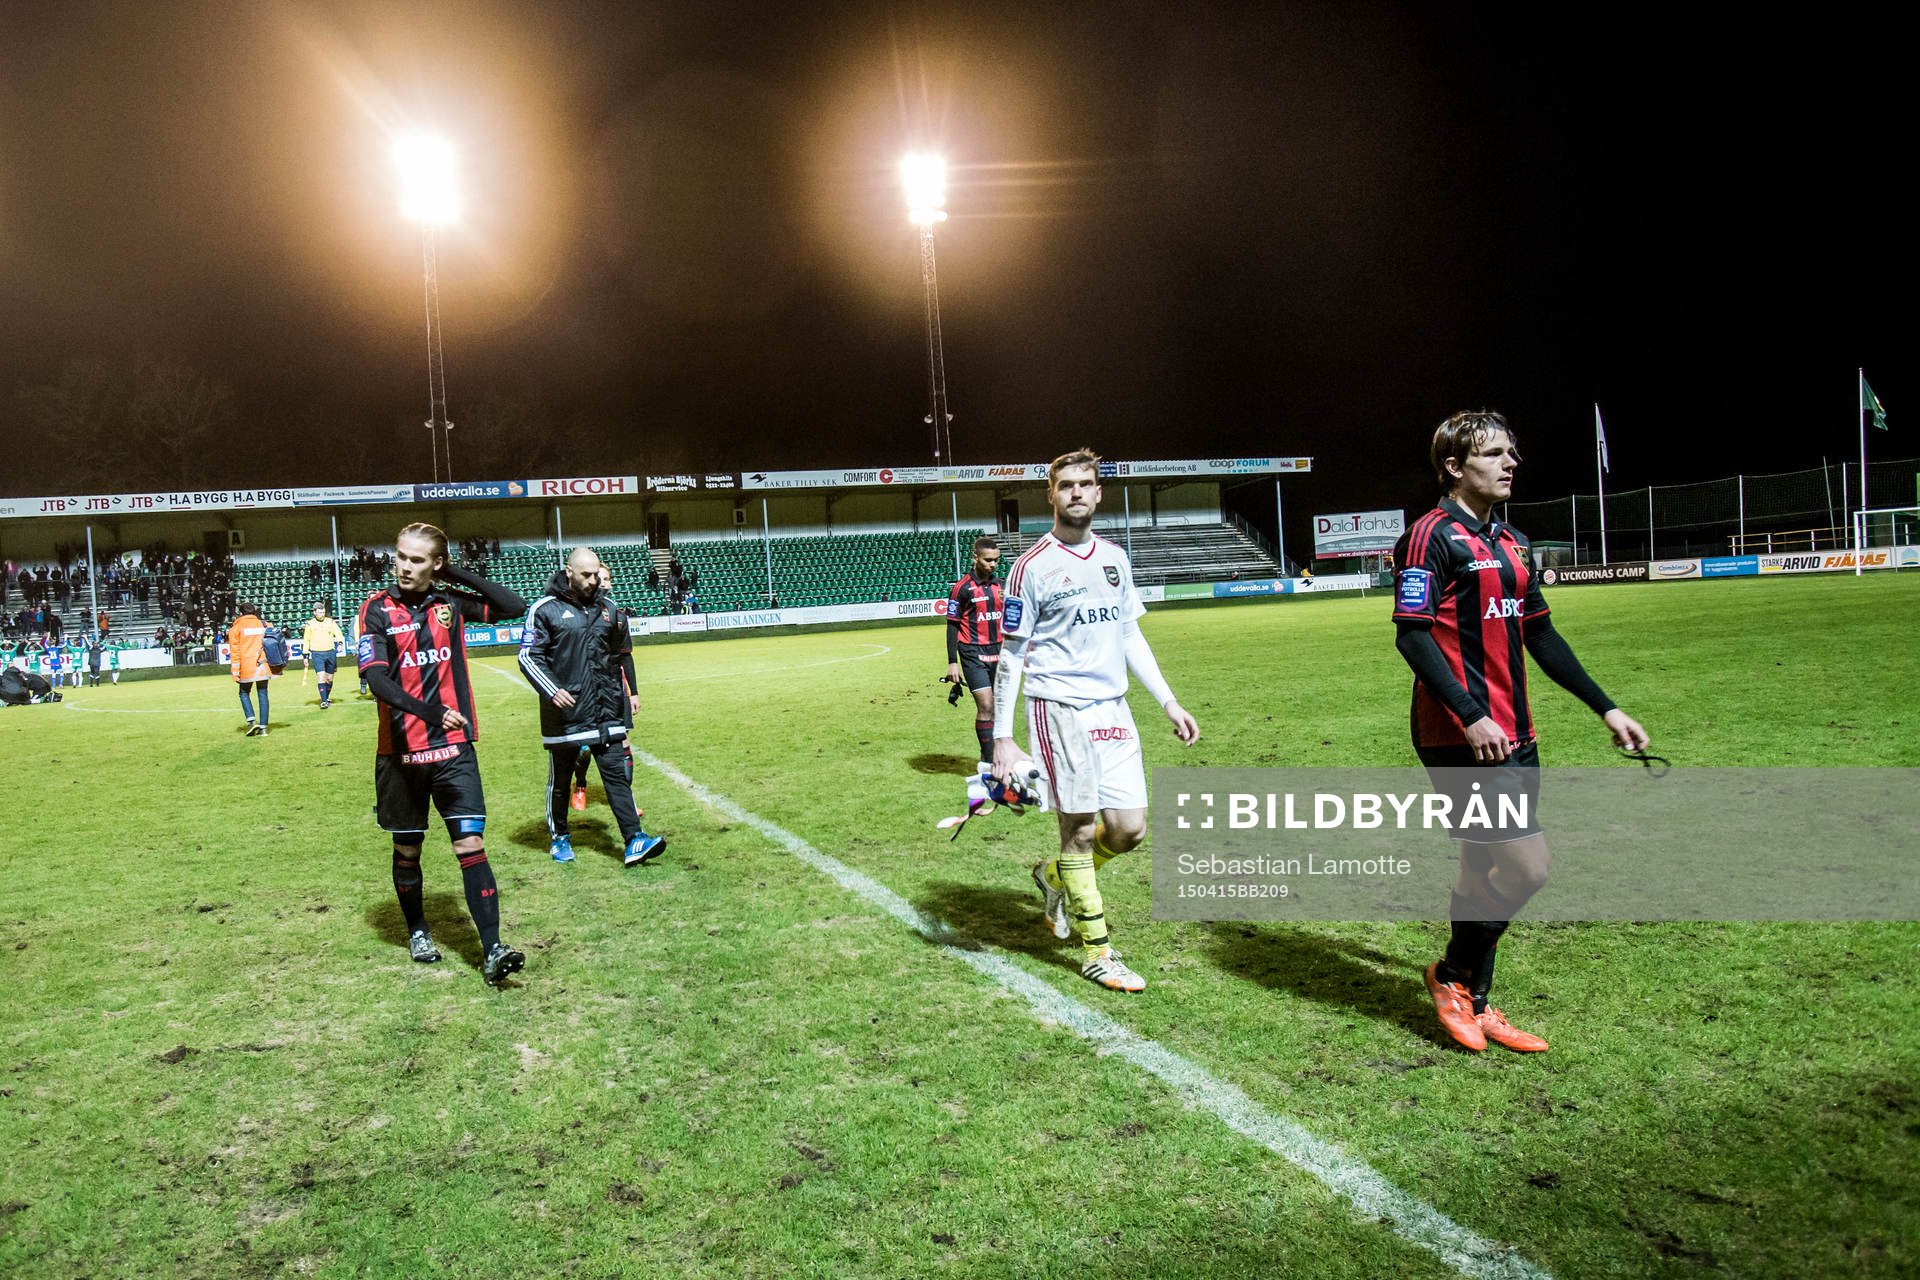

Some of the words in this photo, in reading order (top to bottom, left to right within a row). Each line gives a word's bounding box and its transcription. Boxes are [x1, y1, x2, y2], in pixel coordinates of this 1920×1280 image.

[1188, 464, 1198, 472] AB
[1209, 460, 1235, 469] coop
[1236, 459, 1270, 467] FORUM
[843, 471, 877, 483] COMFORT
[958, 469, 985, 480] ARVID
[541, 478, 624, 496] RICOH
[795, 479, 818, 487] TILLY
[822, 478, 838, 486] SEK
[194, 492, 228, 504] BYGG
[257, 490, 291, 502] BYGG
[421, 485, 500, 498] uddevalla.se
[40, 499, 66, 512] JTB
[84, 498, 110, 511] JTB
[128, 496, 153, 509] JTB
[0, 506, 15, 515] en
[232, 532, 241, 545] A
[1468, 559, 1503, 572] stadium
[1782, 556, 1821, 570] ARVID
[1560, 568, 1614, 582] LYCKORNAS
[1616, 566, 1646, 578] CAMP
[1229, 583, 1270, 593] uddevalla.se
[898, 602, 932, 615] COMFORT
[386, 621, 421, 635] stadium
[403, 745, 460, 763] BAUHAUS
